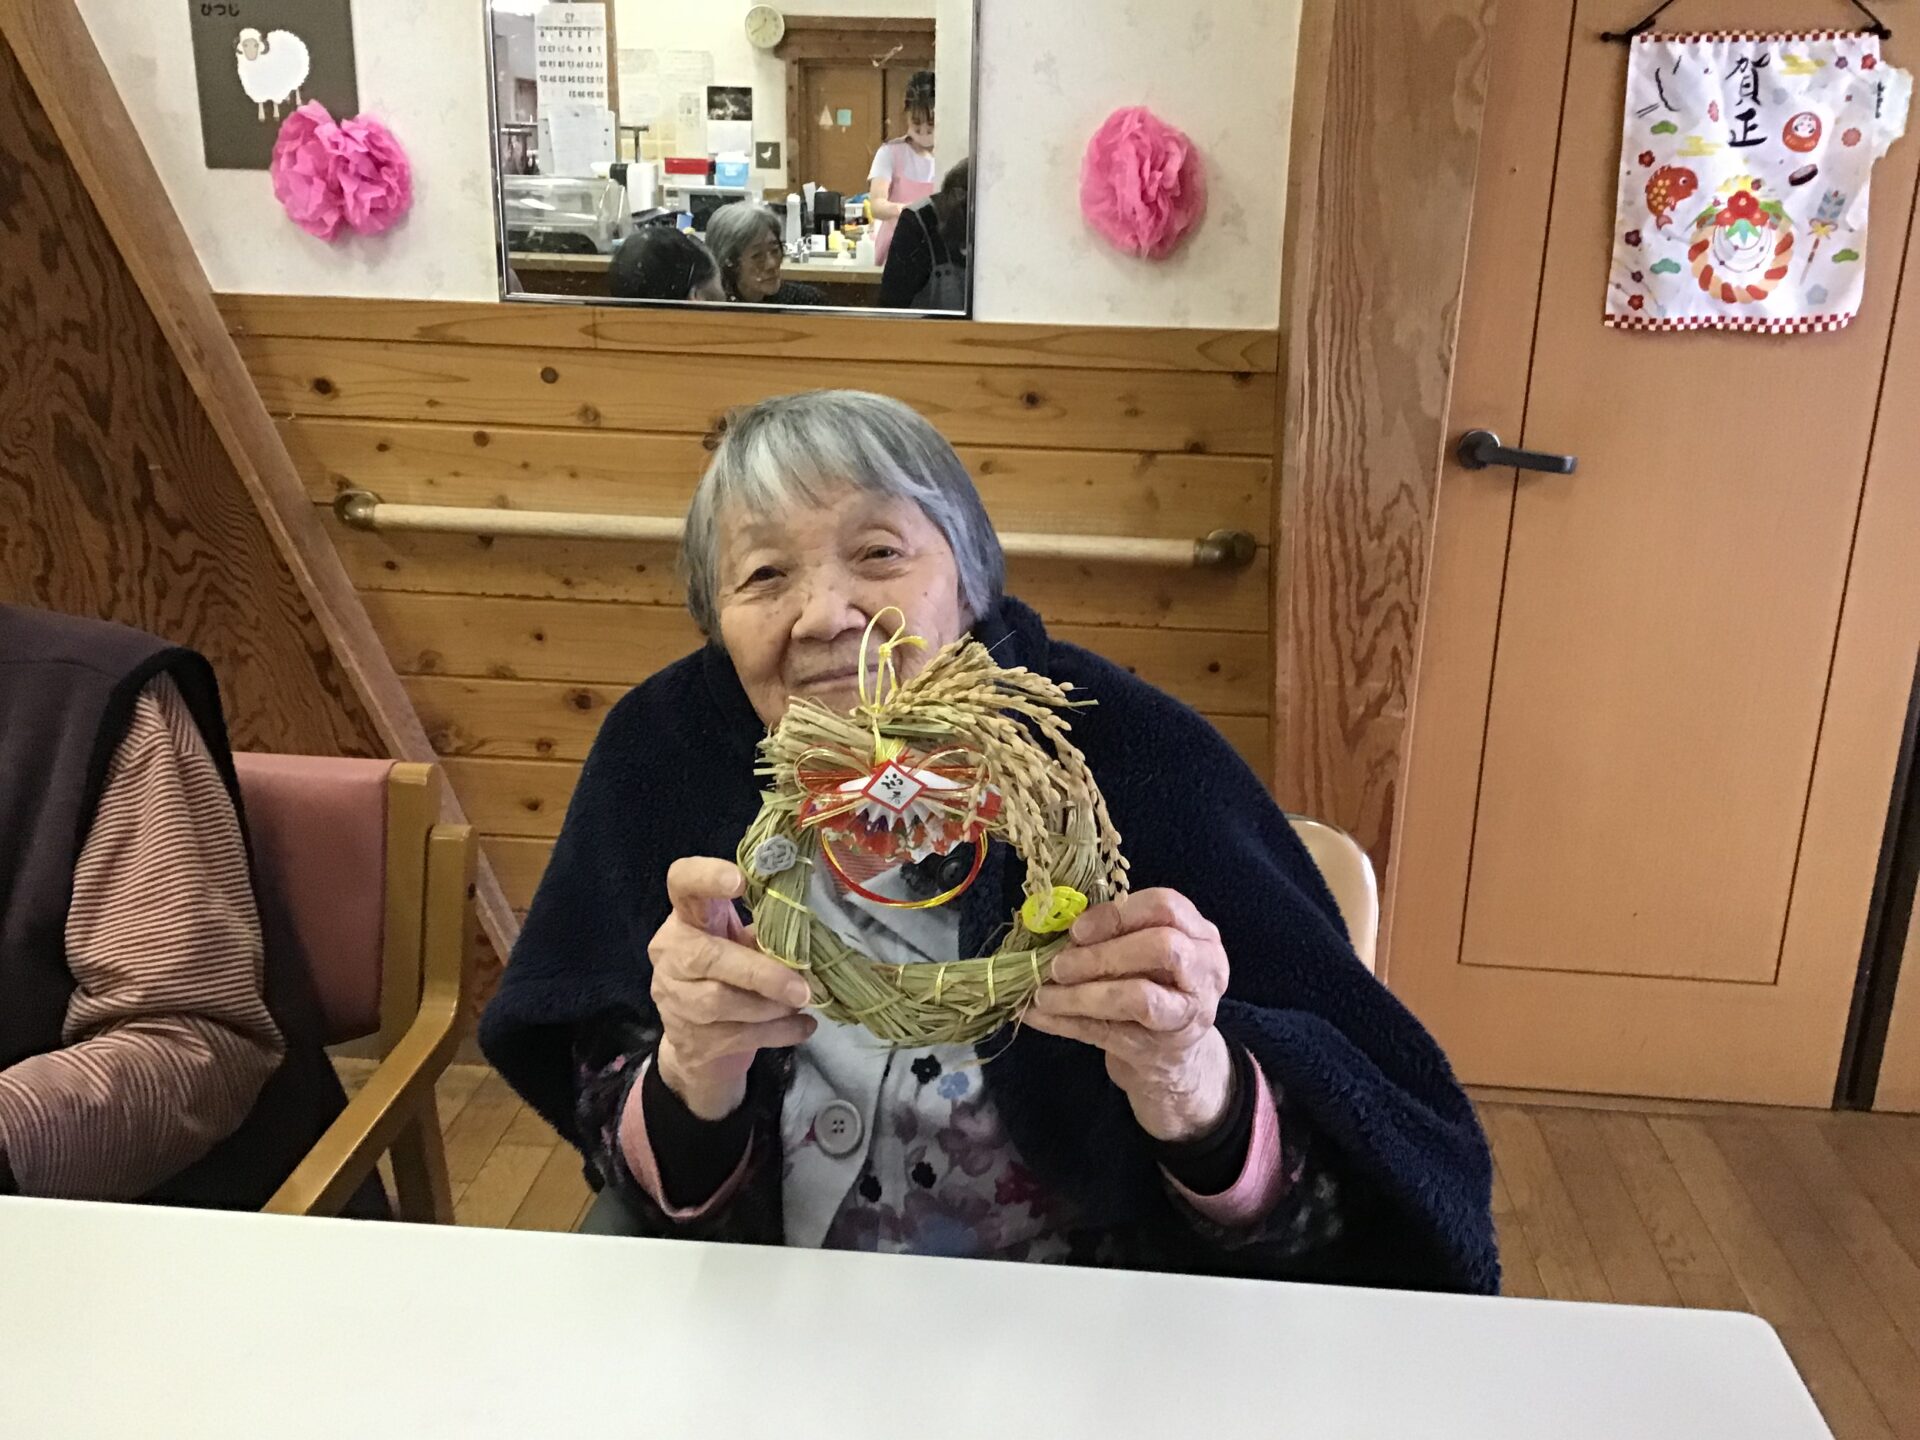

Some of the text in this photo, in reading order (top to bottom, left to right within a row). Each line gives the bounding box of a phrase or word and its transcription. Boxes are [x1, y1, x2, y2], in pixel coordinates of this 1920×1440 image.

[201, 3, 240, 17] ひつじ
[1725, 53, 1770, 147] 賀正
